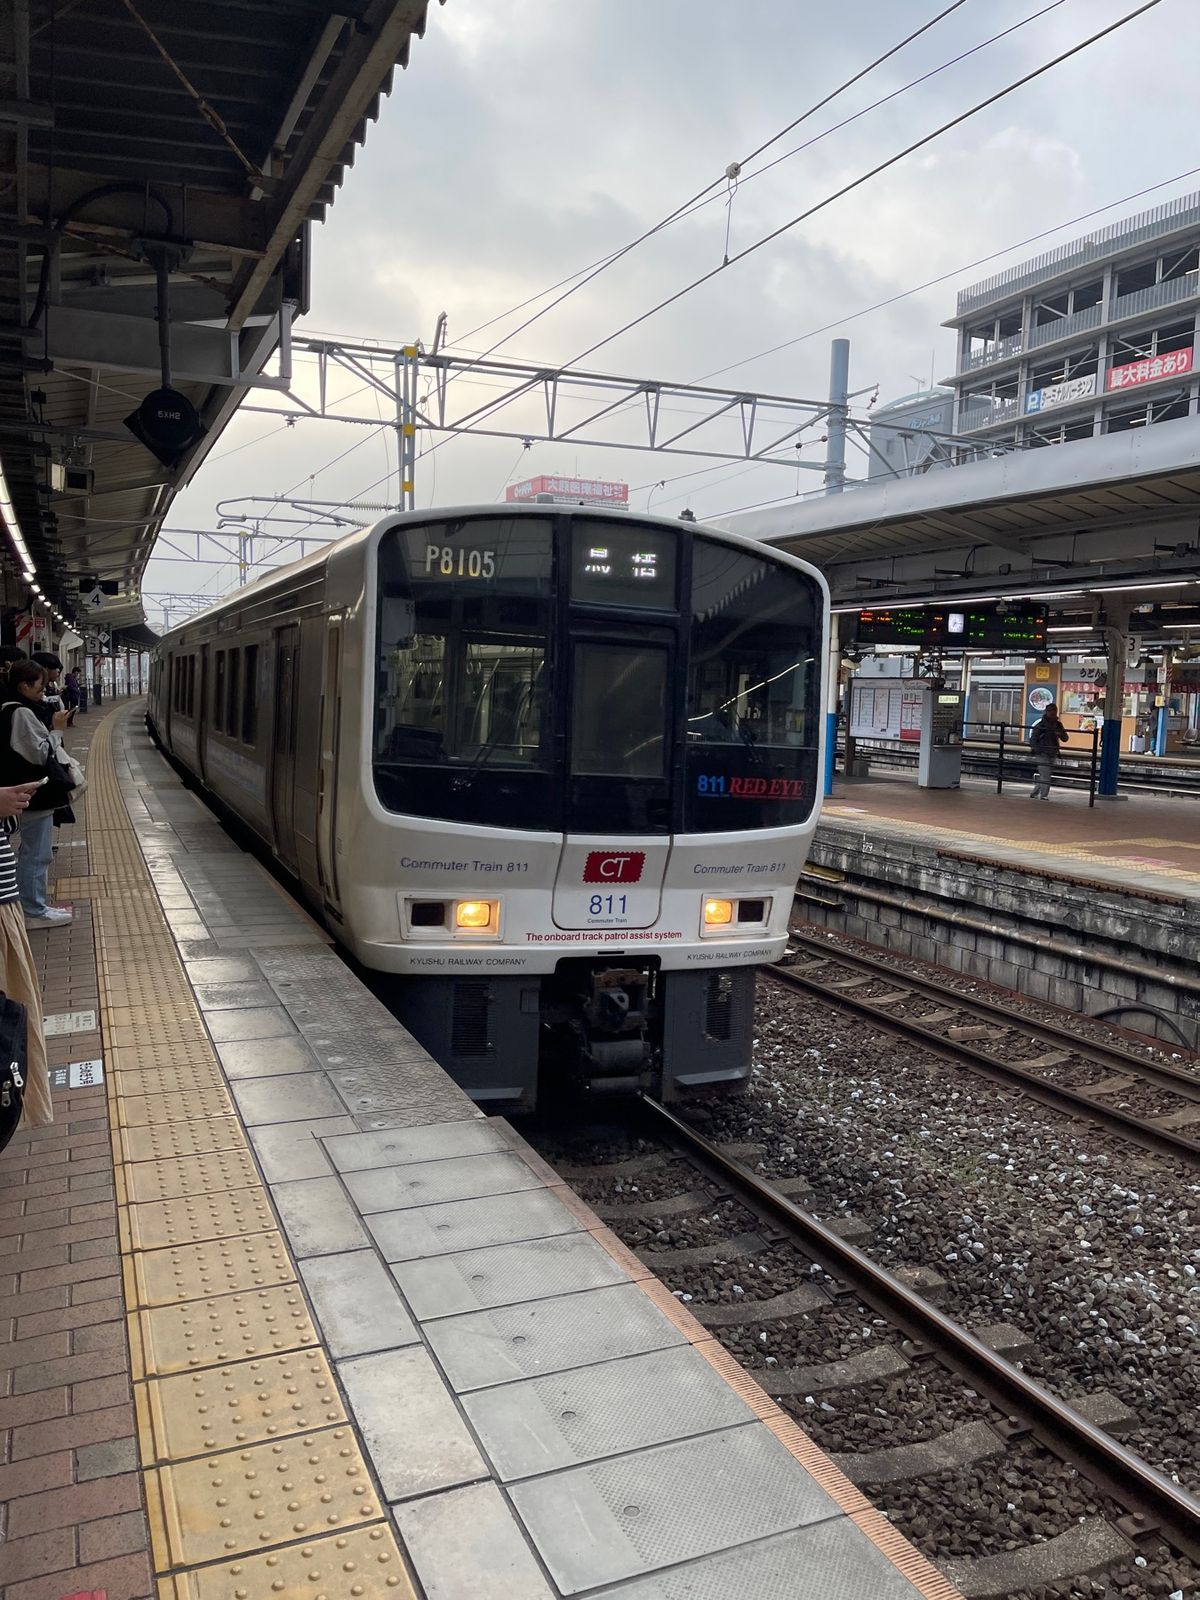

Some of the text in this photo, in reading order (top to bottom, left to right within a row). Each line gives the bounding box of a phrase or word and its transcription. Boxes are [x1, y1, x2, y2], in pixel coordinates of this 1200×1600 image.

[1110, 352, 1188, 388] 最大料金あり
[425, 544, 496, 579] P8105
[91, 593, 101, 606] 4
[1127, 637, 1136, 652] 3
[697, 774, 804, 796] 811 RED EYE
[400, 857, 529, 873] Commuter Train 811
[599, 857, 631, 878] CT
[693, 863, 786, 874] Commuter Train 811
[589, 894, 627, 915] 811
[526, 931, 682, 942] The onboard track patrol assist system
[409, 958, 527, 966] KYUSHU RAILWAY COMPANY
[687, 949, 772, 961] KYUSHU RAILWAY COMPANY
